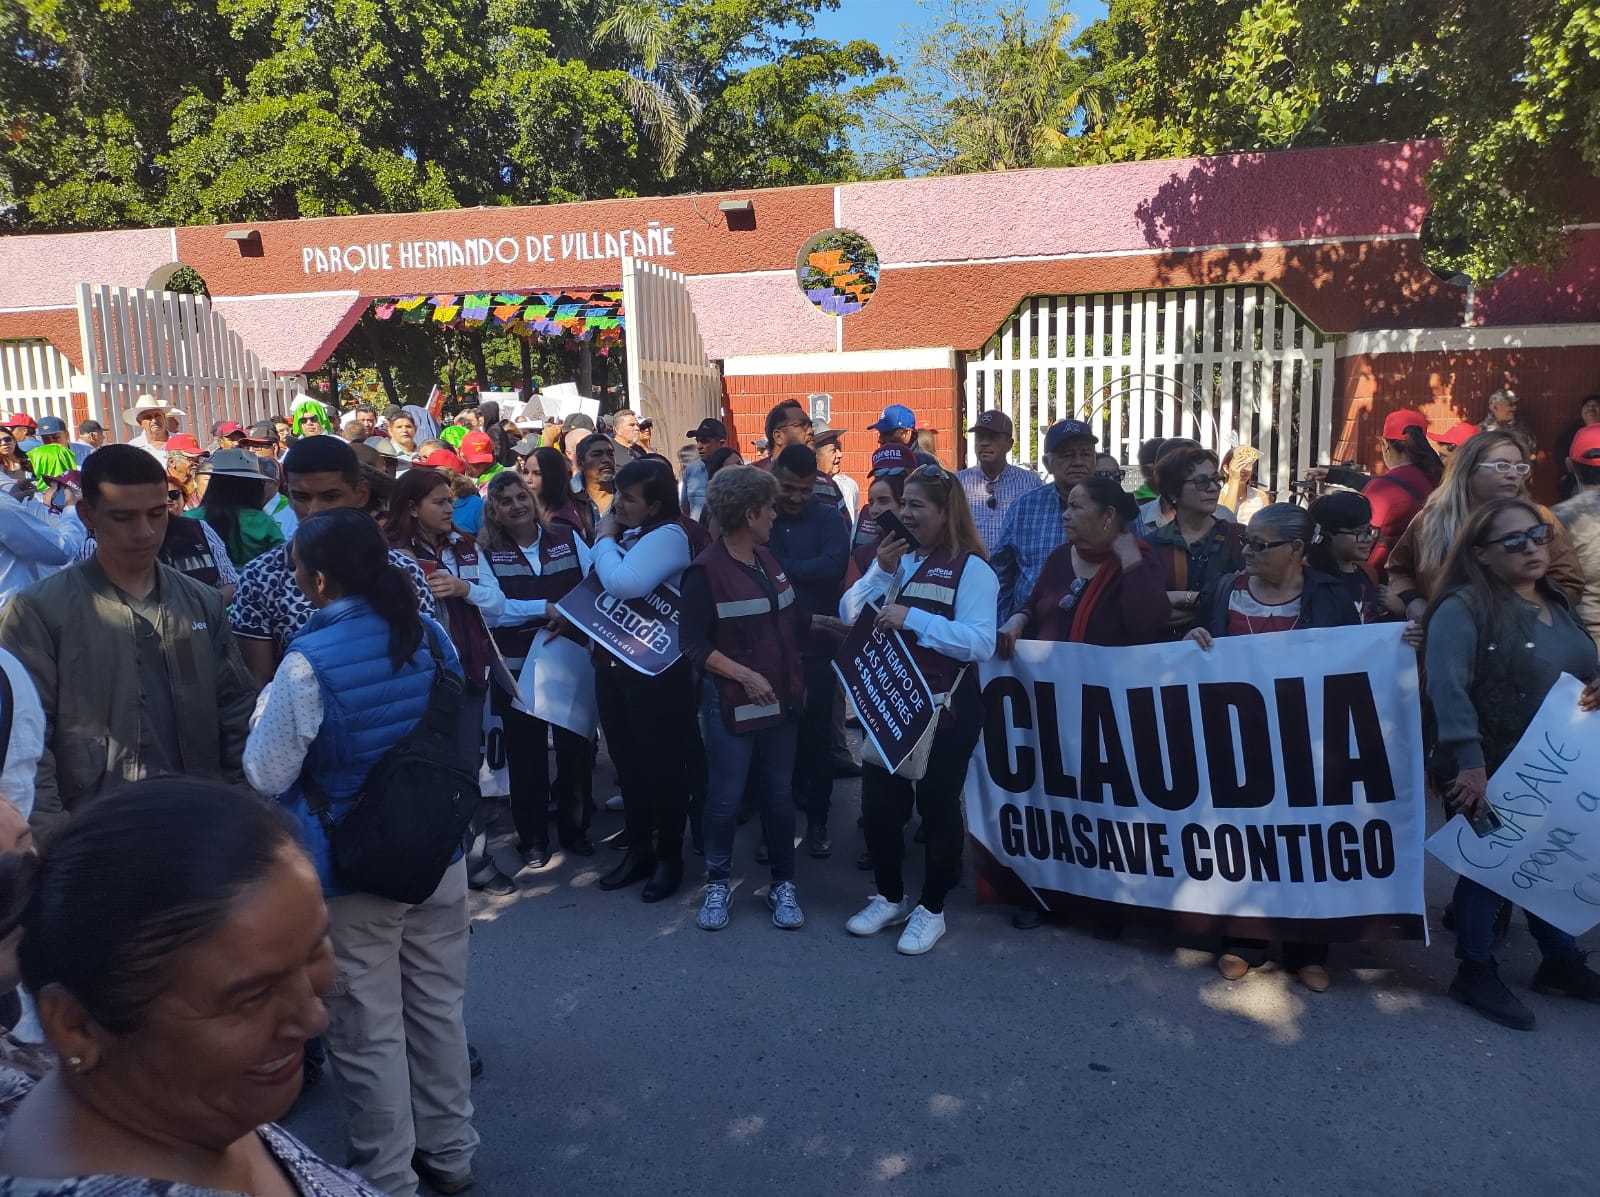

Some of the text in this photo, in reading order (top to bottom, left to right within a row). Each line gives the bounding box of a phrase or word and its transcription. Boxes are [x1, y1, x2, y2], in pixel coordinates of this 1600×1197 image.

[303, 221, 676, 274] PARQUE HERNANDO DE VILLAFAÑE
[594, 589, 672, 654] Claudia
[860, 668, 903, 742] Sheinbaum
[863, 641, 913, 726] LAS MUJERES
[871, 626, 925, 713] ES TIEMPO DE
[980, 671, 1397, 811] CLAUDIA
[1457, 730, 1581, 870] GUASAVE
[999, 803, 1396, 883] GUASAVE CONTIGO
[1511, 826, 1589, 890] apoya
